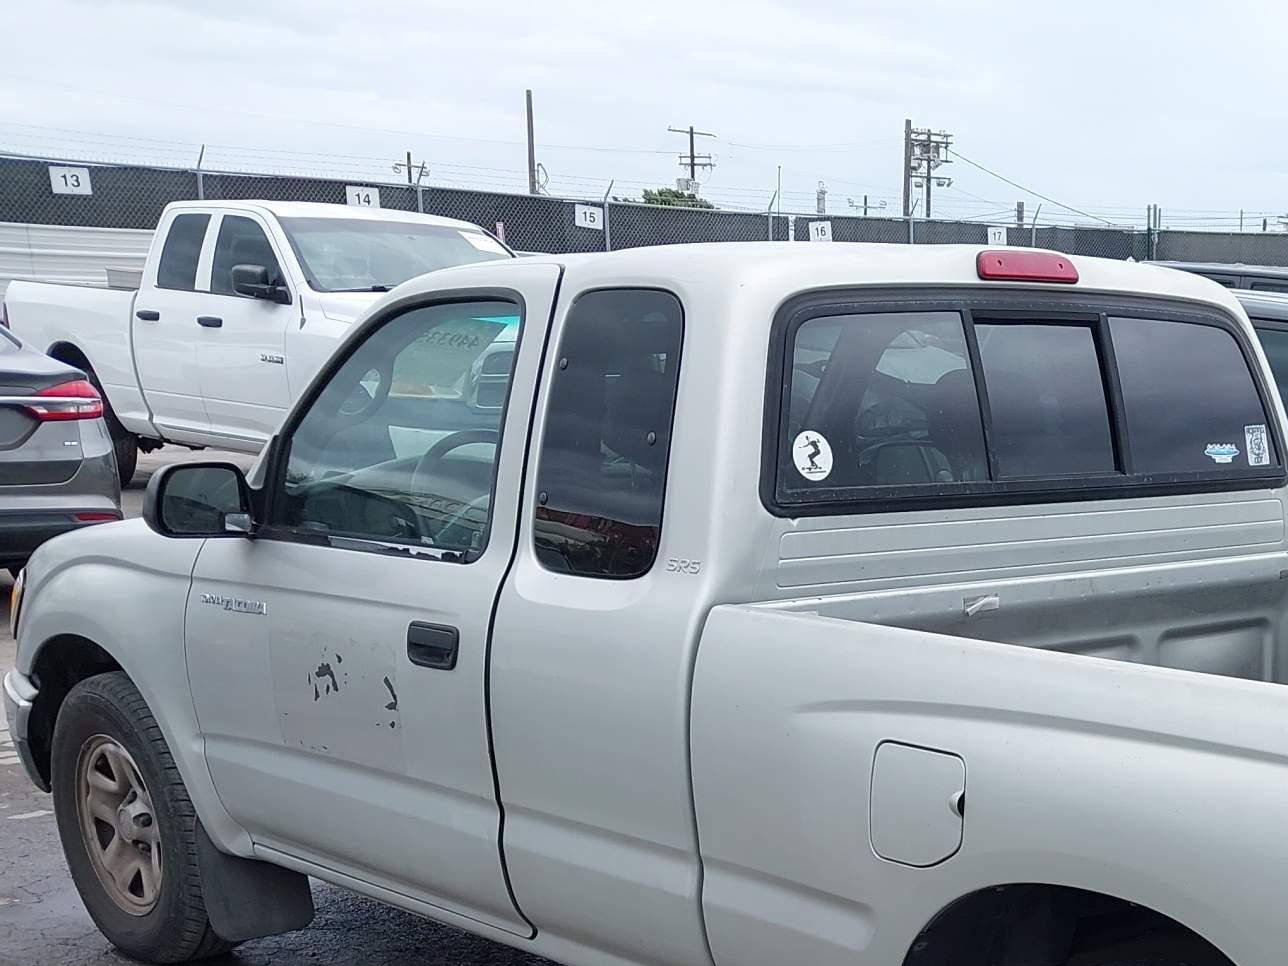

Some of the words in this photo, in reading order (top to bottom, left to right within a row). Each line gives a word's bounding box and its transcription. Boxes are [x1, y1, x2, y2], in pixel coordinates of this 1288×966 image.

[60, 173, 81, 188] 13
[354, 192, 371, 206] 14
[582, 211, 596, 223] 15
[815, 226, 826, 237] 16
[993, 231, 1002, 241] 17
